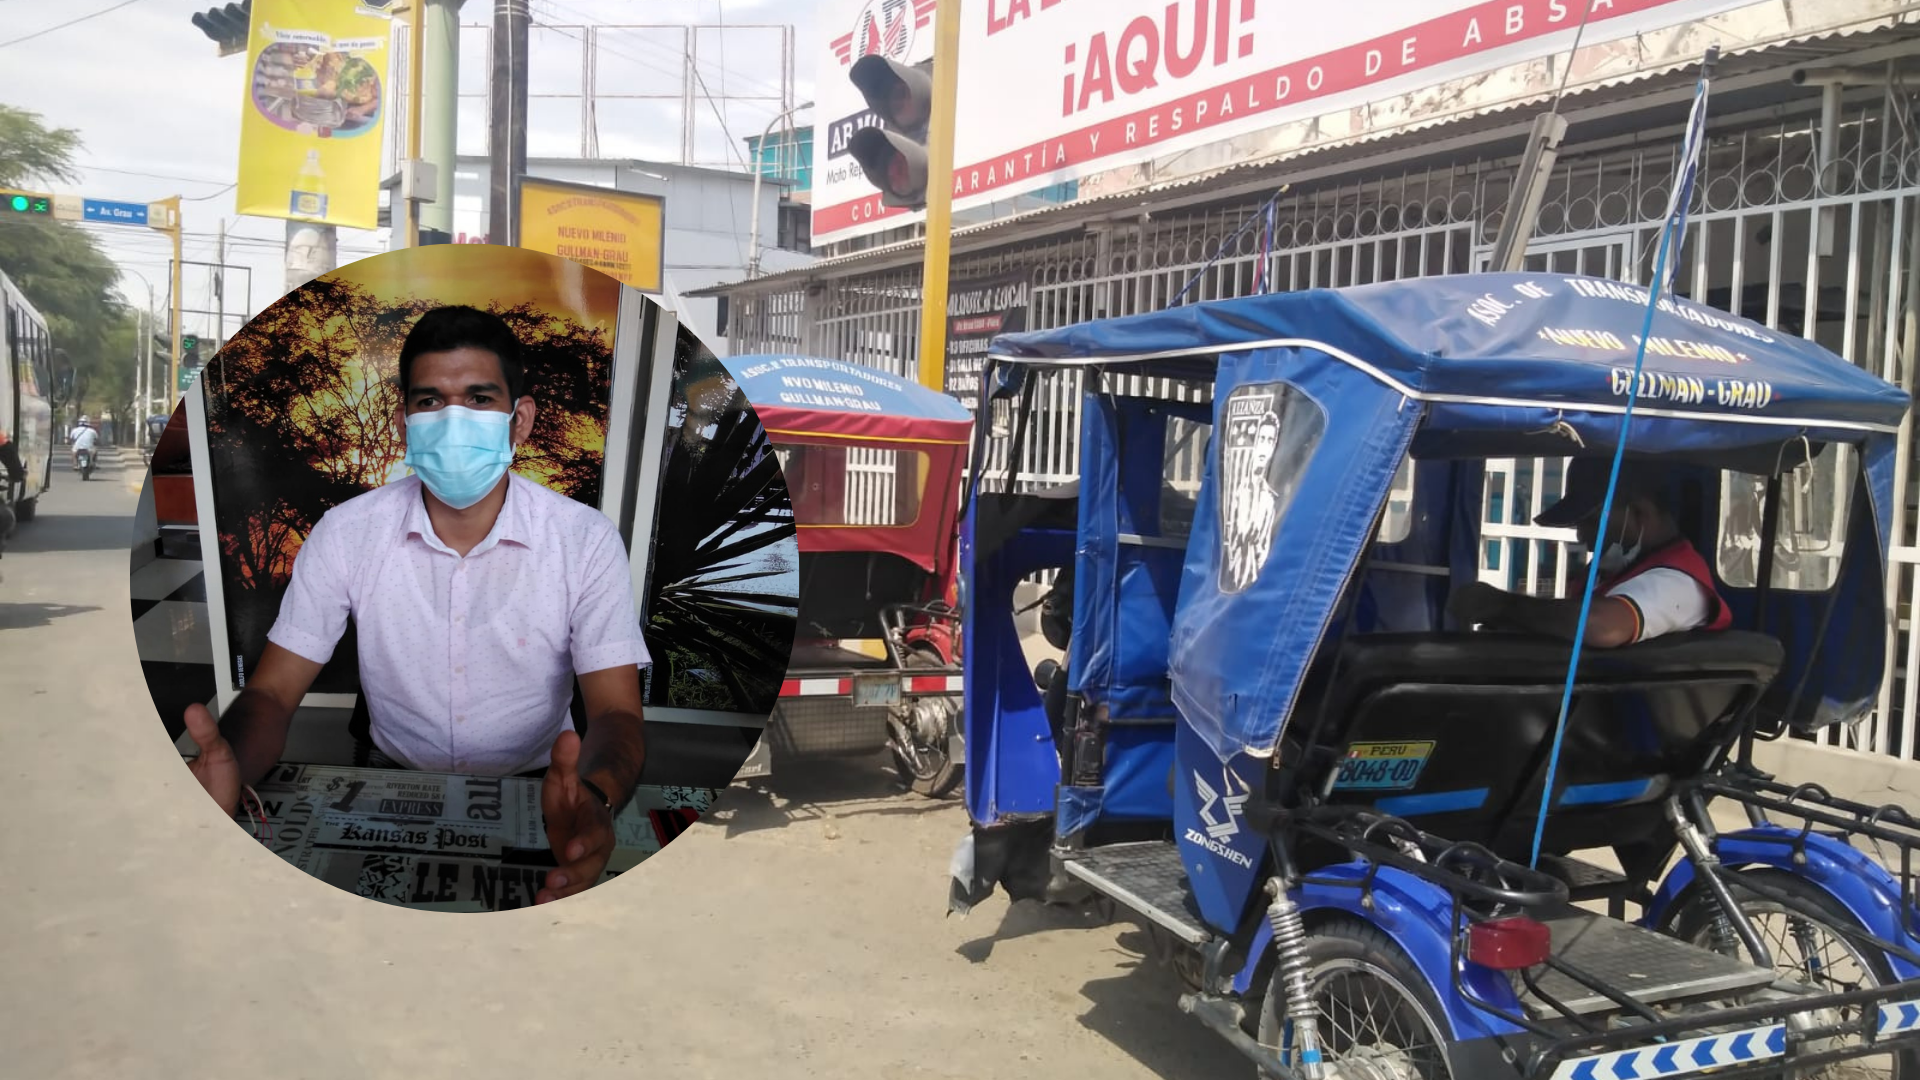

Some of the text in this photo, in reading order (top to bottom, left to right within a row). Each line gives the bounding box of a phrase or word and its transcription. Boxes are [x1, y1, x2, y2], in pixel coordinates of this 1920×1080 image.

[851, 198, 885, 221] CON
[953, 141, 1067, 194] ARANTÍA
[1090, 131, 1101, 154] Y
[1126, 65, 1325, 144] RESPALDO
[1365, 39, 1417, 78] DE
[100, 206, 133, 218] Av. Grau
[558, 226, 627, 243] NUEVO MILENIO
[1516, 280, 1554, 299] DE
[1547, 328, 1738, 364] NUEVO MILENIO
[780, 358, 903, 393] TRANSPORTADORES
[813, 378, 865, 398] MILENIO
[1370, 745, 1407, 756] PERU
[386, 782, 441, 793] RIVERTON RATE
[397, 789, 430, 799] REDUCED
[381, 799, 444, 817] EXPRESS
[341, 821, 488, 850] Kansas Post
[1184, 828, 1253, 869] ZONGSHEN
[411, 862, 459, 903] LE
